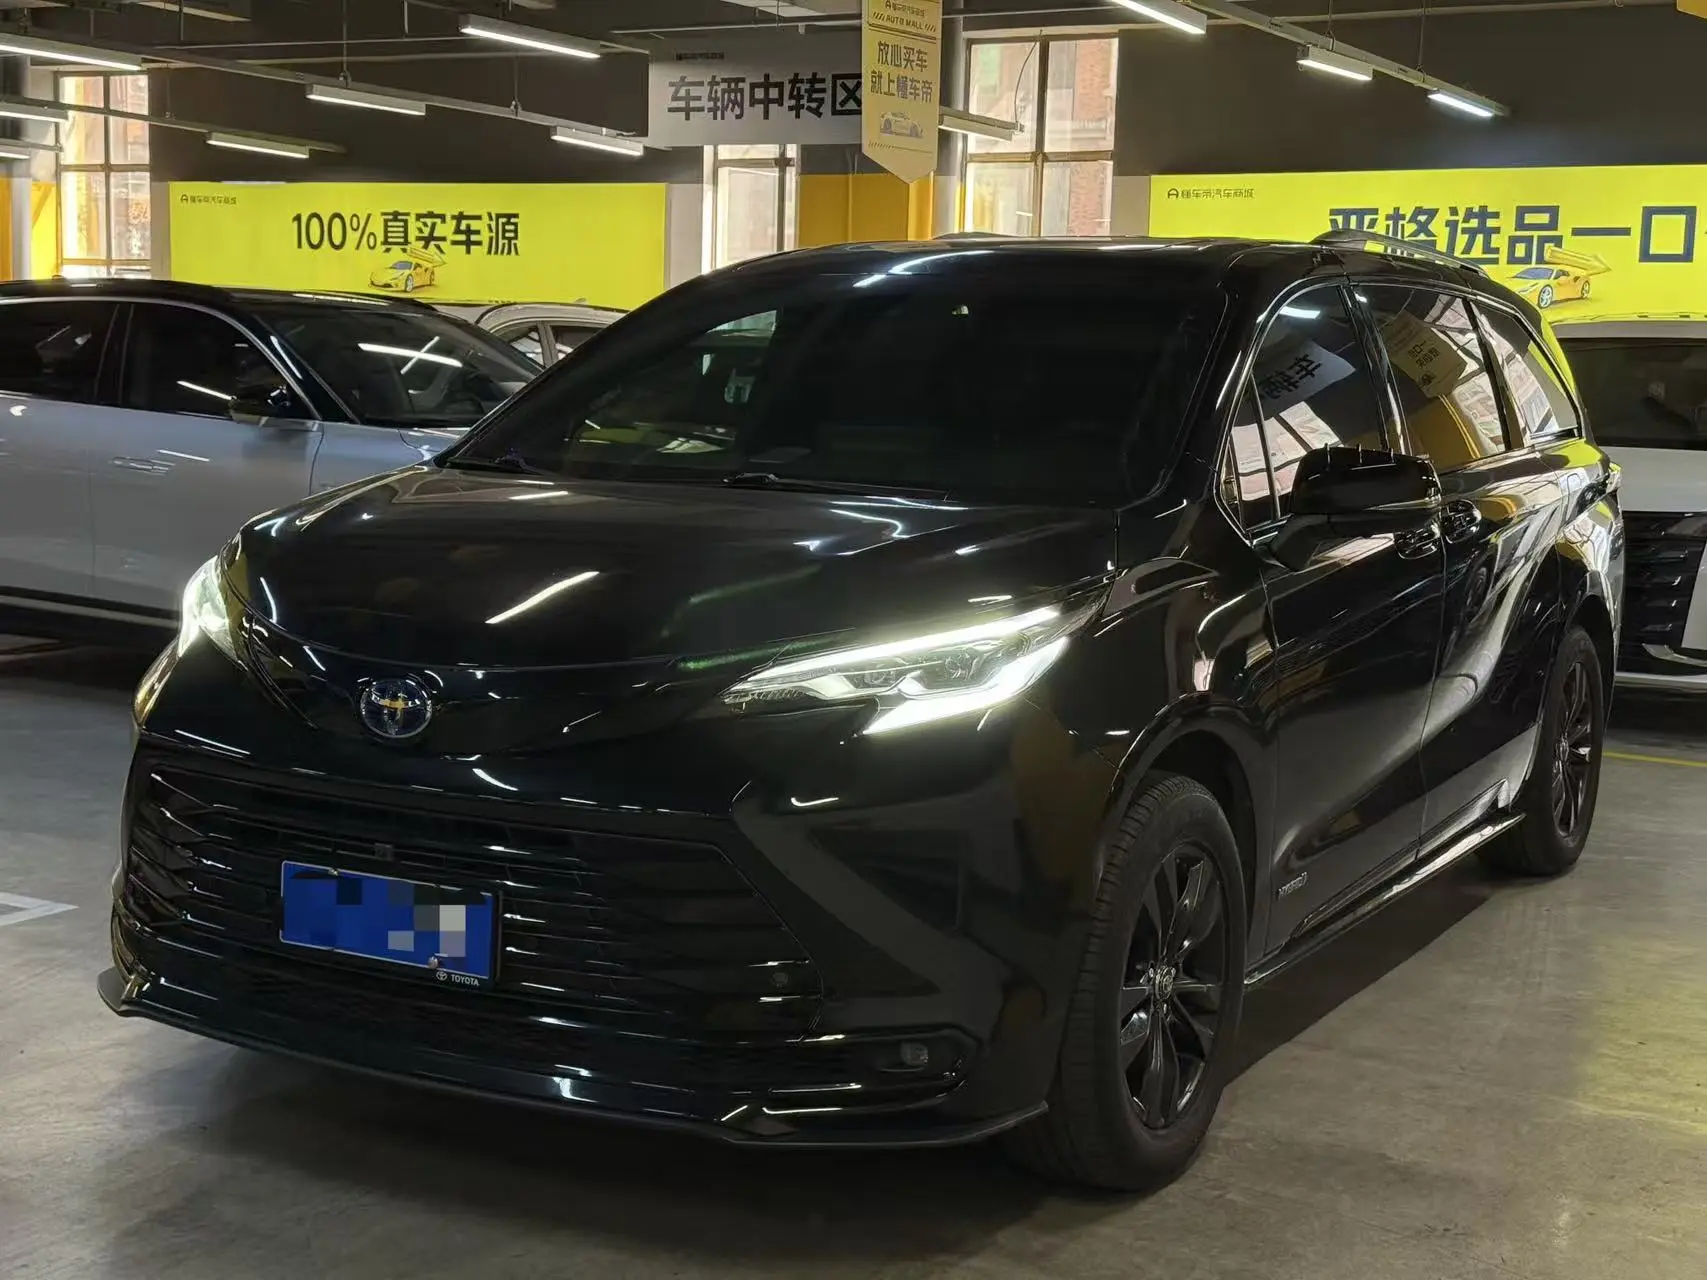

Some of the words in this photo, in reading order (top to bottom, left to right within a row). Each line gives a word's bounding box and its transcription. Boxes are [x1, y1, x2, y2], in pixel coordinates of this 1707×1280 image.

[905, 19, 923, 30] MALL
[878, 40, 928, 72] 放心买车
[667, 72, 862, 121] 车辆中转区
[870, 69, 933, 103] 就上懂车帝
[292, 210, 520, 256] 100%真实车源
[451, 974, 480, 986] TOYOTA
